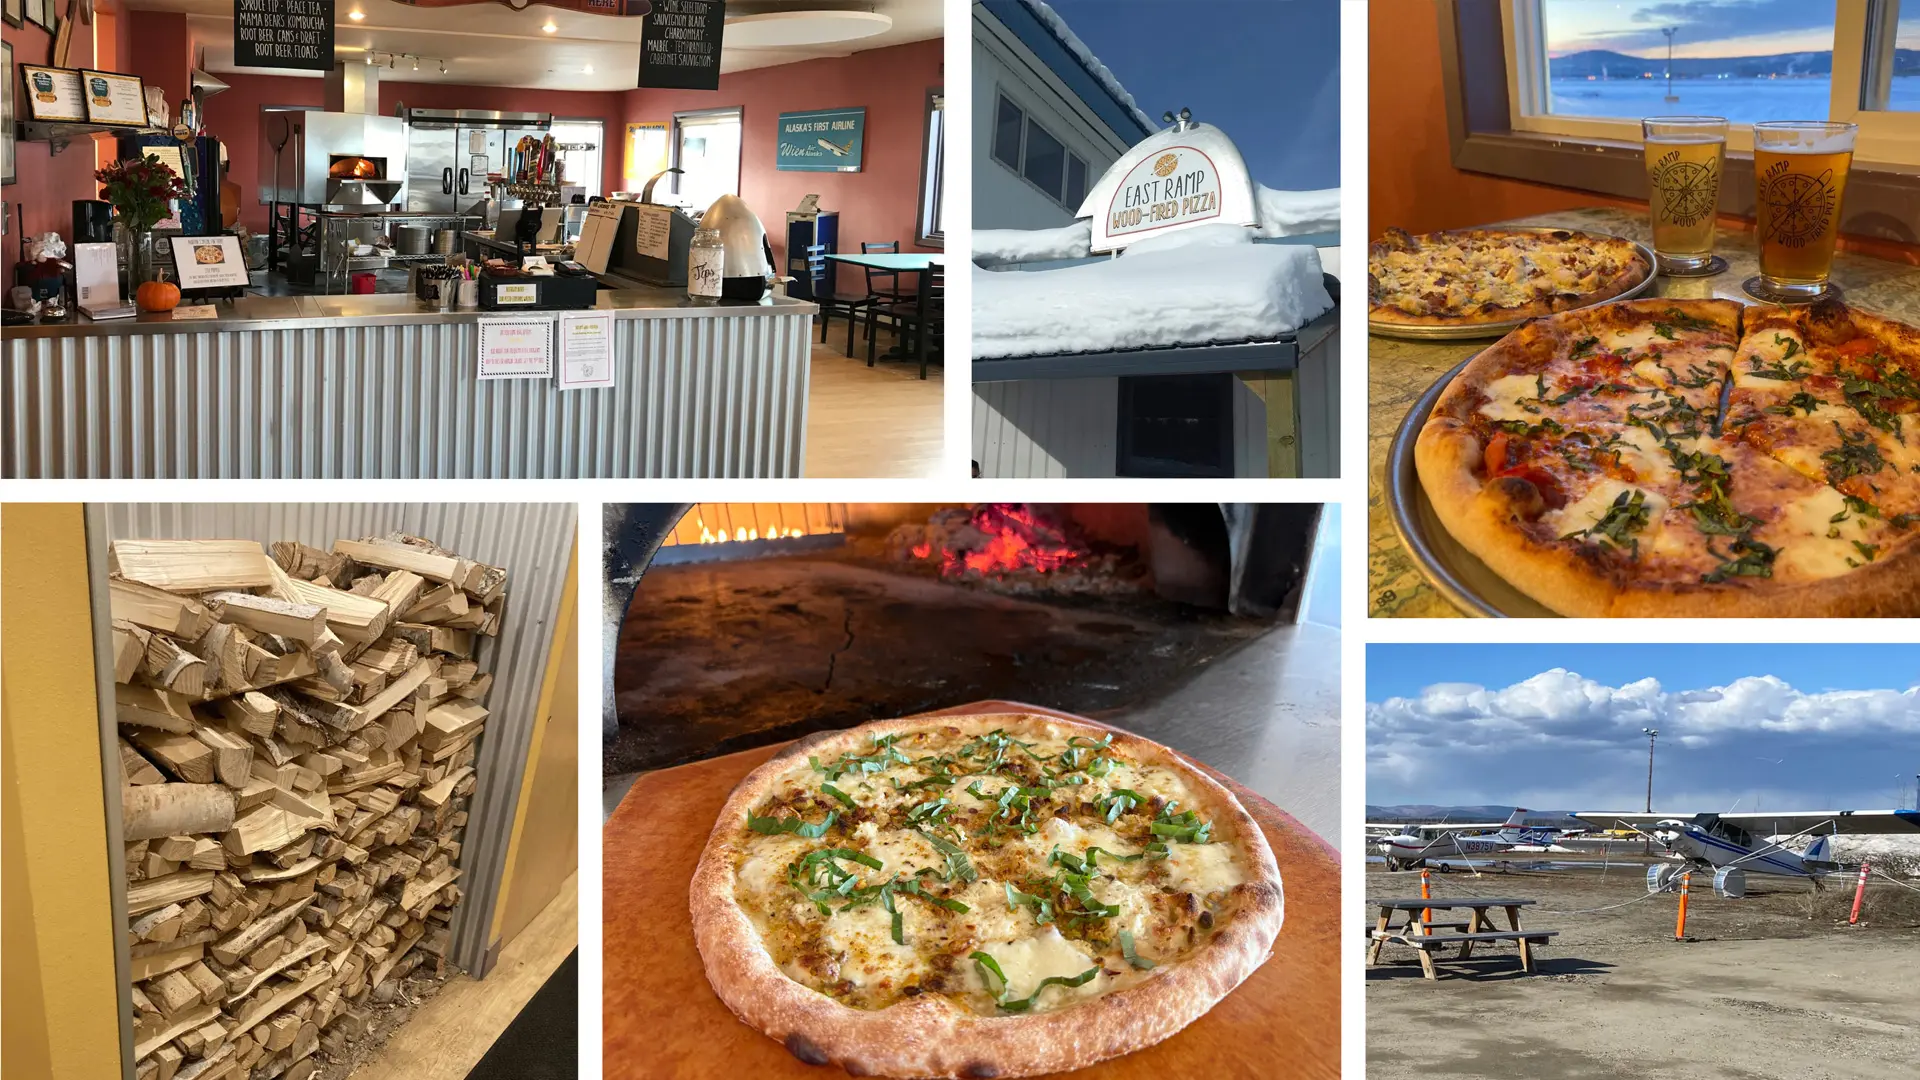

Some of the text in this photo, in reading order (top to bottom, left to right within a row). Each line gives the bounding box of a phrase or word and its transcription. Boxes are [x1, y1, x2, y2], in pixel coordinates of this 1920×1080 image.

[241, 0, 321, 15] SPRUCE TIP PEACE TEA
[663, 1, 708, 14] WINE SELECTION
[240, 12, 325, 30] MAMA BEAR'S KOMBUCHA
[653, 14, 706, 27] SAUVIGNON BLANC
[240, 28, 257, 41] ROOT
[258, 28, 274, 42] BEER
[277, 30, 295, 43] CANS
[300, 31, 320, 44] DRAFT
[664, 27, 705, 40] CHARDONNAY
[255, 43, 319, 59] ROOT BEER FLOATS
[647, 40, 712, 53] MALBEC TEMPRANILLO
[649, 53, 712, 67] CABERNET SAUVIGNON
[785, 120, 855, 133] ALASKA'S FIRST AIRLINE
[780, 142, 805, 157] Wien
[1652, 150, 1680, 188] EAST RAMP
[1765, 160, 1789, 180] RAMP
[1125, 170, 1205, 208] EAST RAMP
[1711, 171, 1719, 198] PIZZA
[1112, 191, 1216, 229] WOOD-FIRED PIZZA
[691, 261, 715, 285] Tips
[1466, 840, 1494, 851] N3875V
